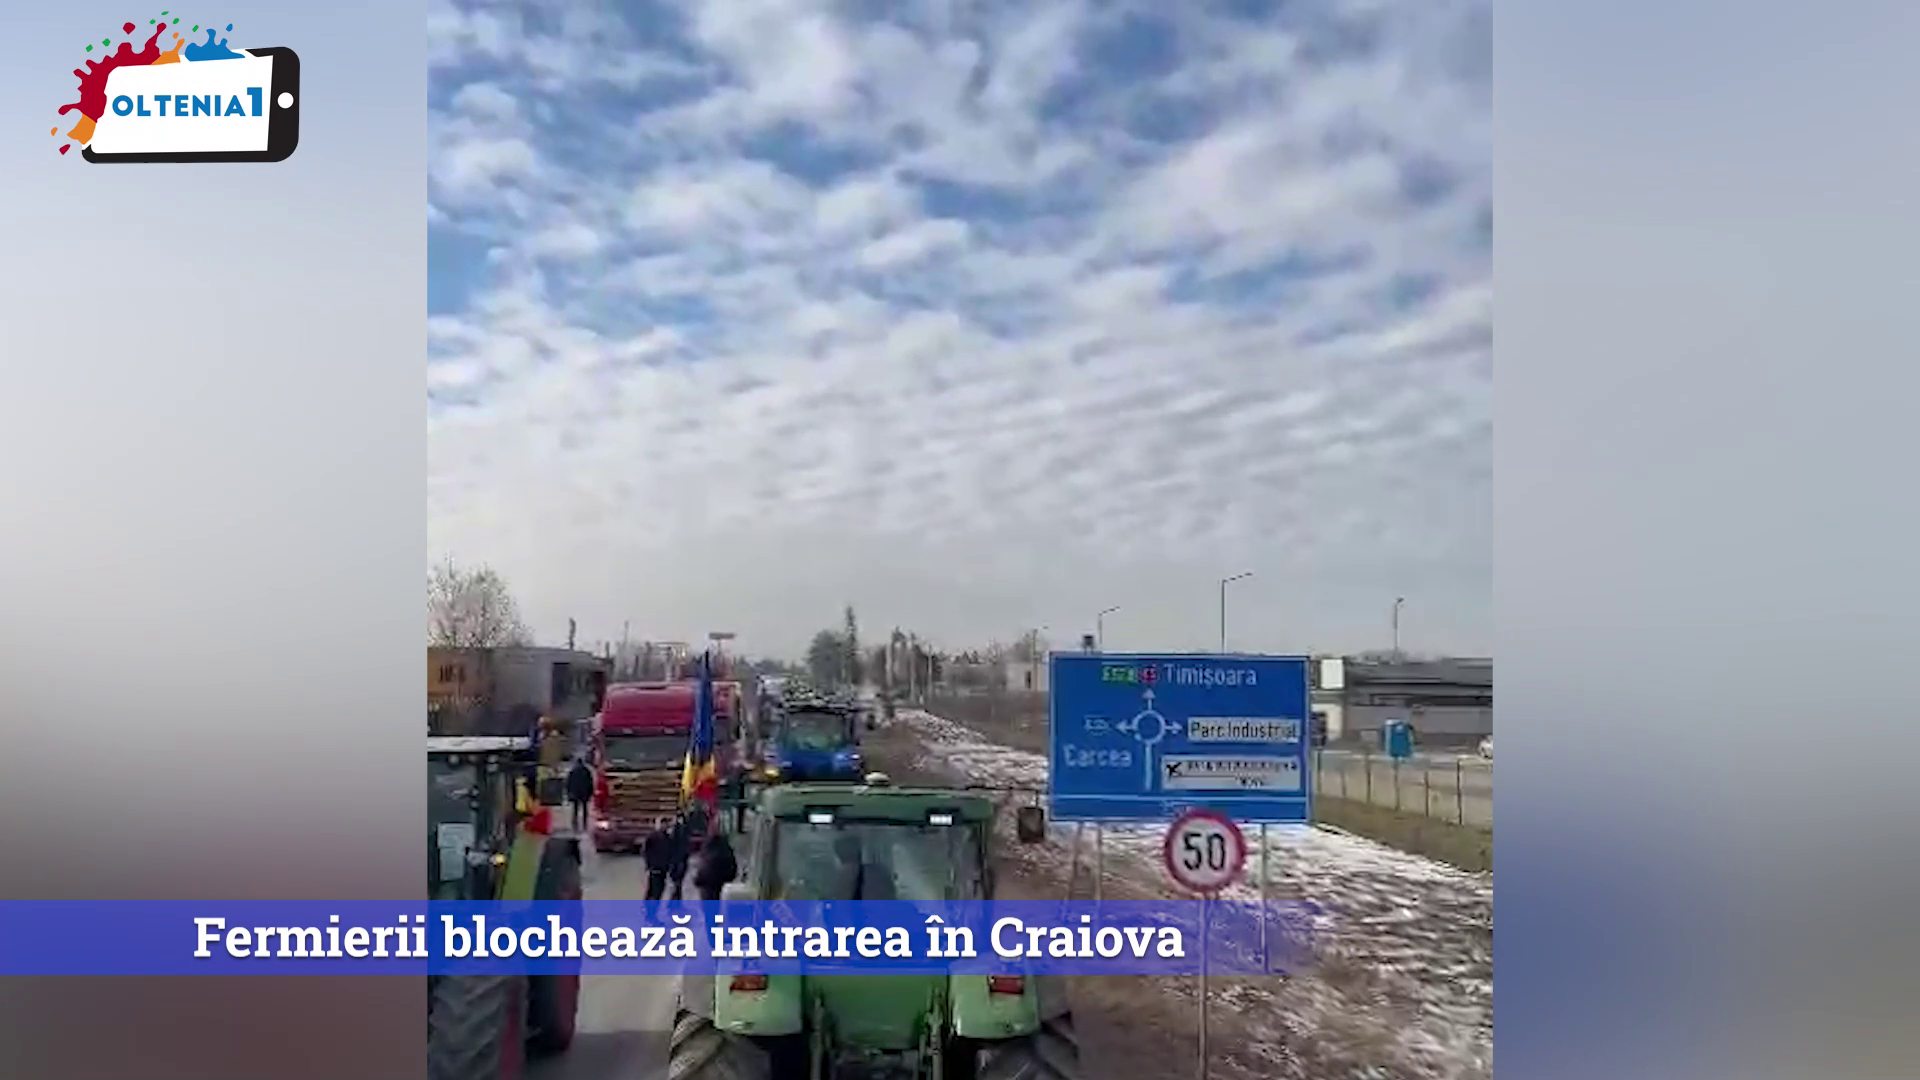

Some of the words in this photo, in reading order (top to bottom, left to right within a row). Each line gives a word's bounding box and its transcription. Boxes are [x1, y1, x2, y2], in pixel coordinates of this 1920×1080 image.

[1163, 663, 1257, 688] Timișoara
[1190, 721, 1225, 739] Parc
[1228, 721, 1297, 739] Industrial
[1183, 833, 1226, 872] 50
